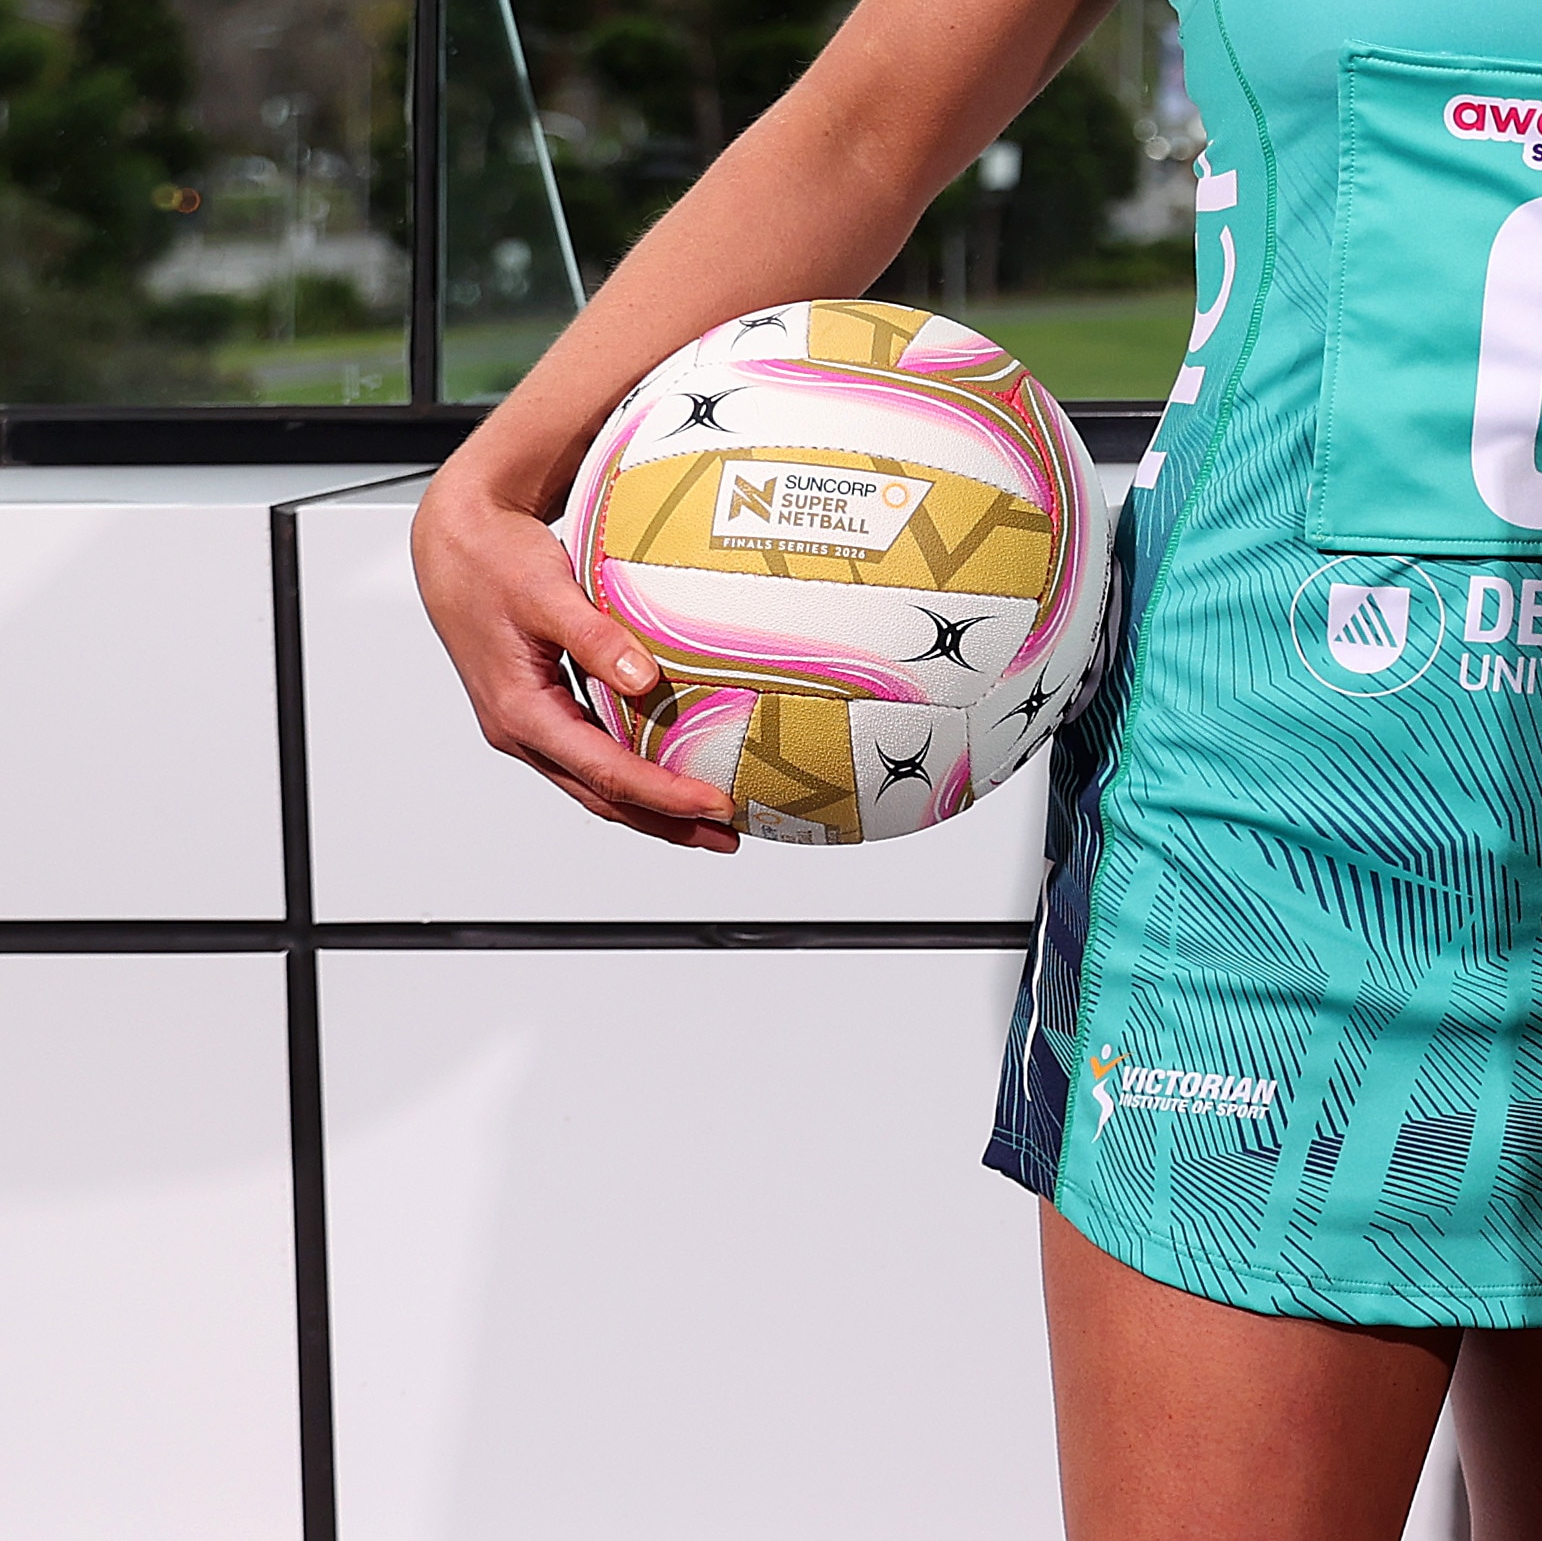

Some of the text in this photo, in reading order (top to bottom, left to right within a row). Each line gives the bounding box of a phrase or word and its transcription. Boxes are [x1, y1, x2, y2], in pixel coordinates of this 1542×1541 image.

[785, 474, 877, 497] SUNCORP
[781, 493, 848, 514] SUPER
[777, 510, 869, 534] NETBALL
[723, 537, 866, 559] FINALS SERIES 2026
[1122, 1065, 1278, 1105] VICTORIAN
[1119, 1093, 1270, 1120] INSTITUTE OF SPORT
